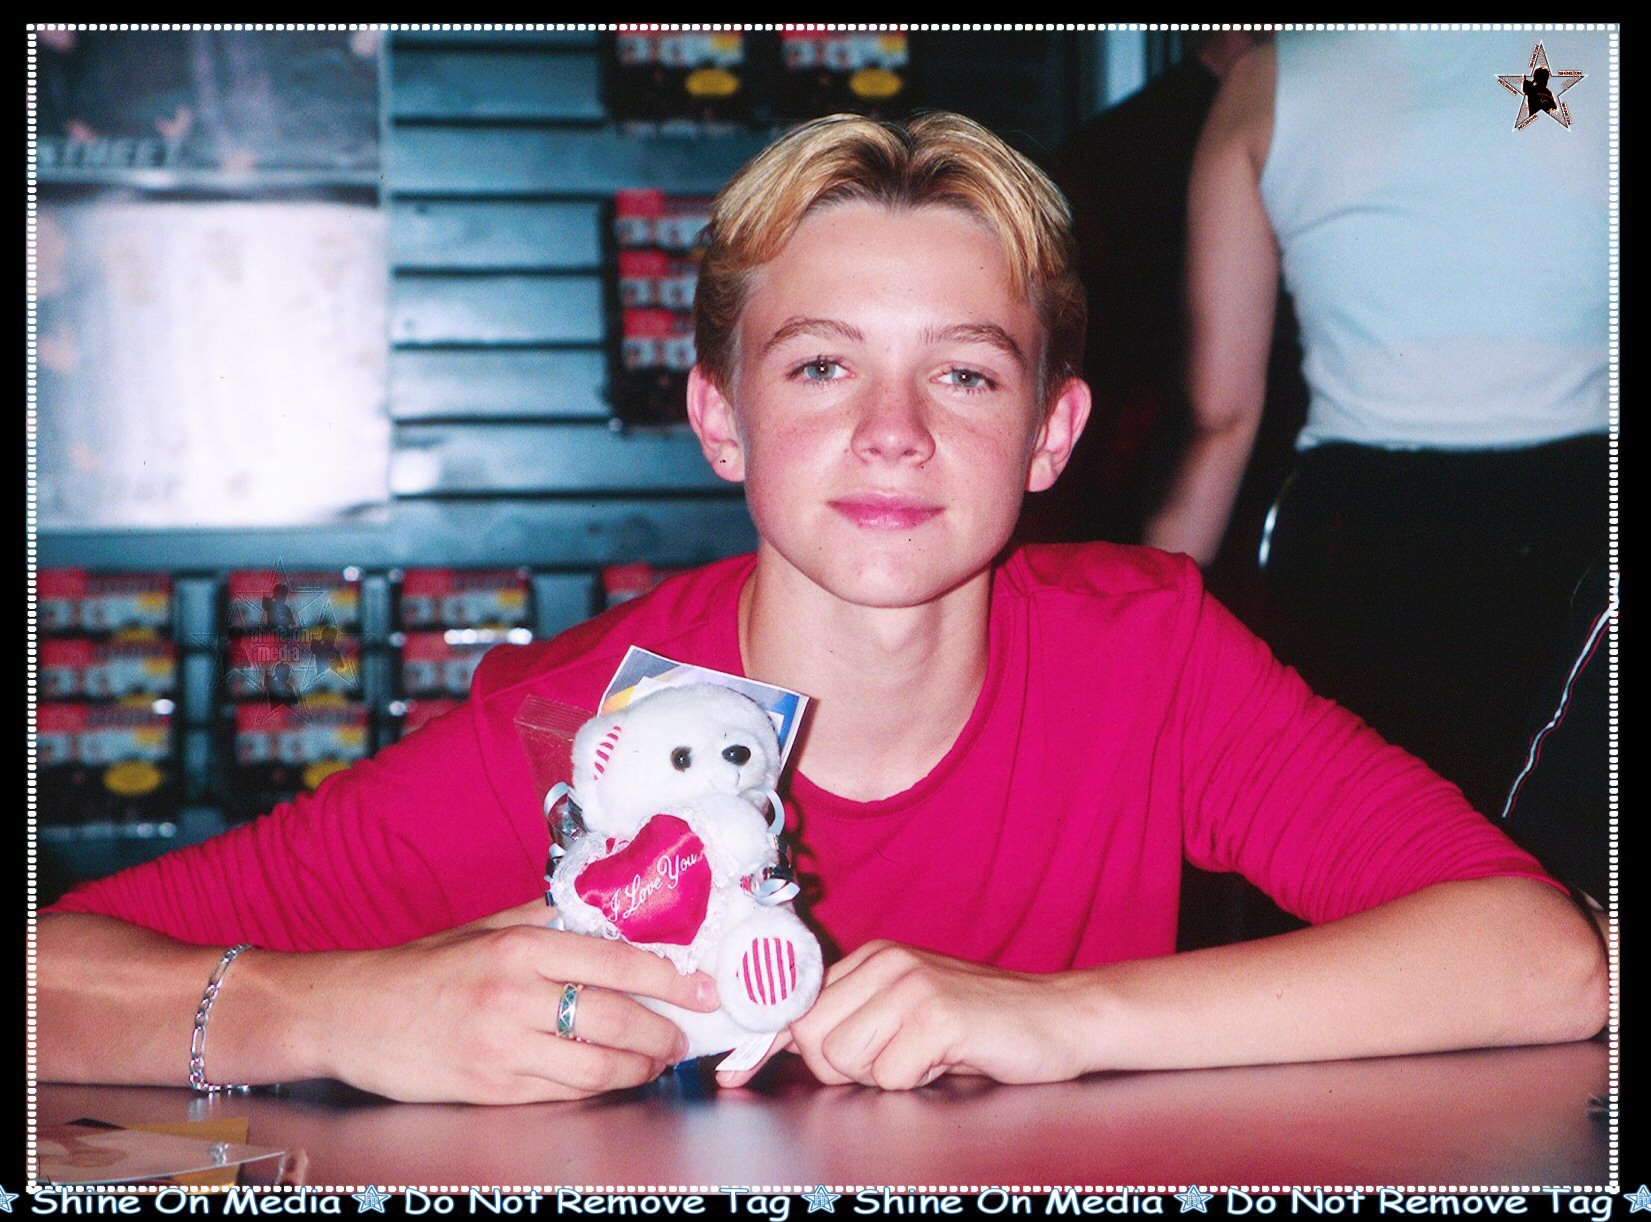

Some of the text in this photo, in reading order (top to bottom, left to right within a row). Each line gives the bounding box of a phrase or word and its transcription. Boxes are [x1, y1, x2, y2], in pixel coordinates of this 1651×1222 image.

[607, 854, 698, 922] I Love You
